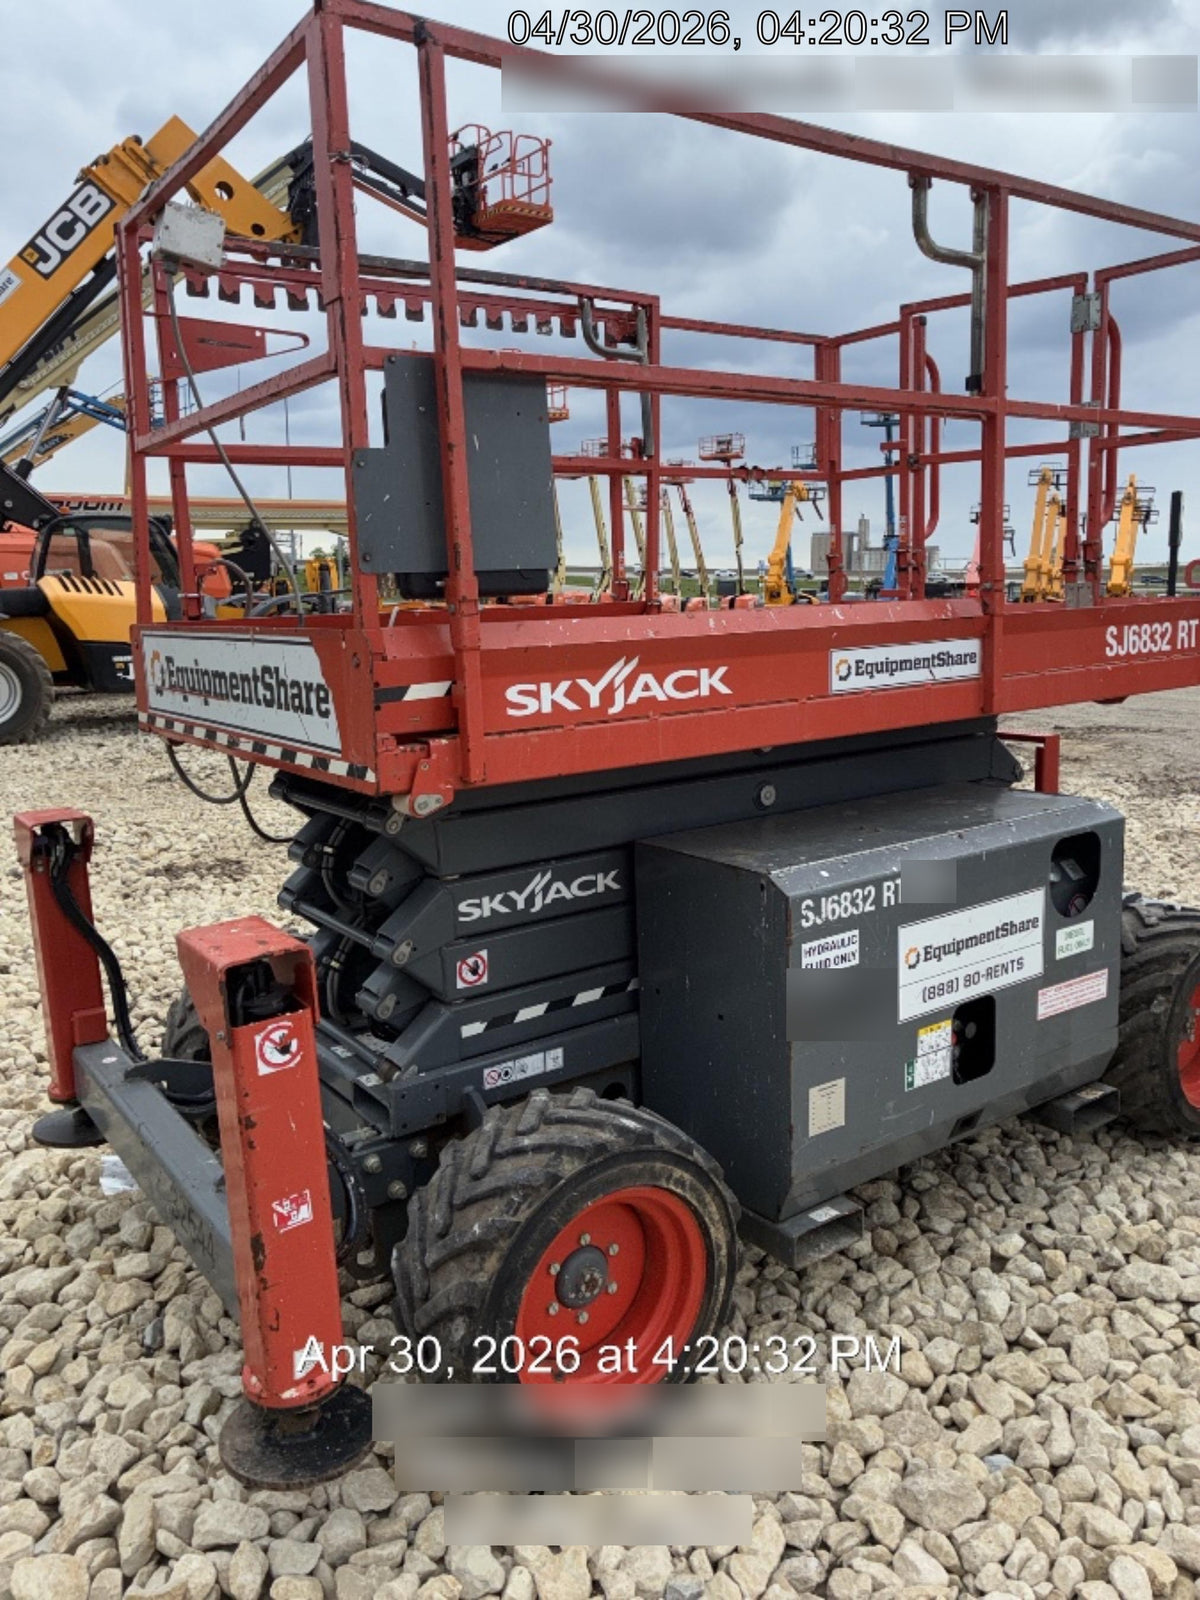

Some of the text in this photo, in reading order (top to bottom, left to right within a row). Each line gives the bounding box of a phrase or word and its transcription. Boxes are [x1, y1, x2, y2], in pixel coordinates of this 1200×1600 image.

[34, 184, 111, 275] JCB
[1105, 618, 1199, 657] SJ6832 RT
[164, 654, 331, 719] EquipmentShare
[504, 655, 733, 717] SKYJACK
[854, 650, 977, 679] EquipmentShare
[457, 869, 622, 922] SKYJACK
[801, 884, 876, 928] SJ6832
[803, 934, 858, 959] HYDRAULIC
[833, 949, 858, 967] ONLY
[922, 916, 1040, 963] EquipmentShare
[922, 956, 1025, 1003] (888) 80-RENTS
